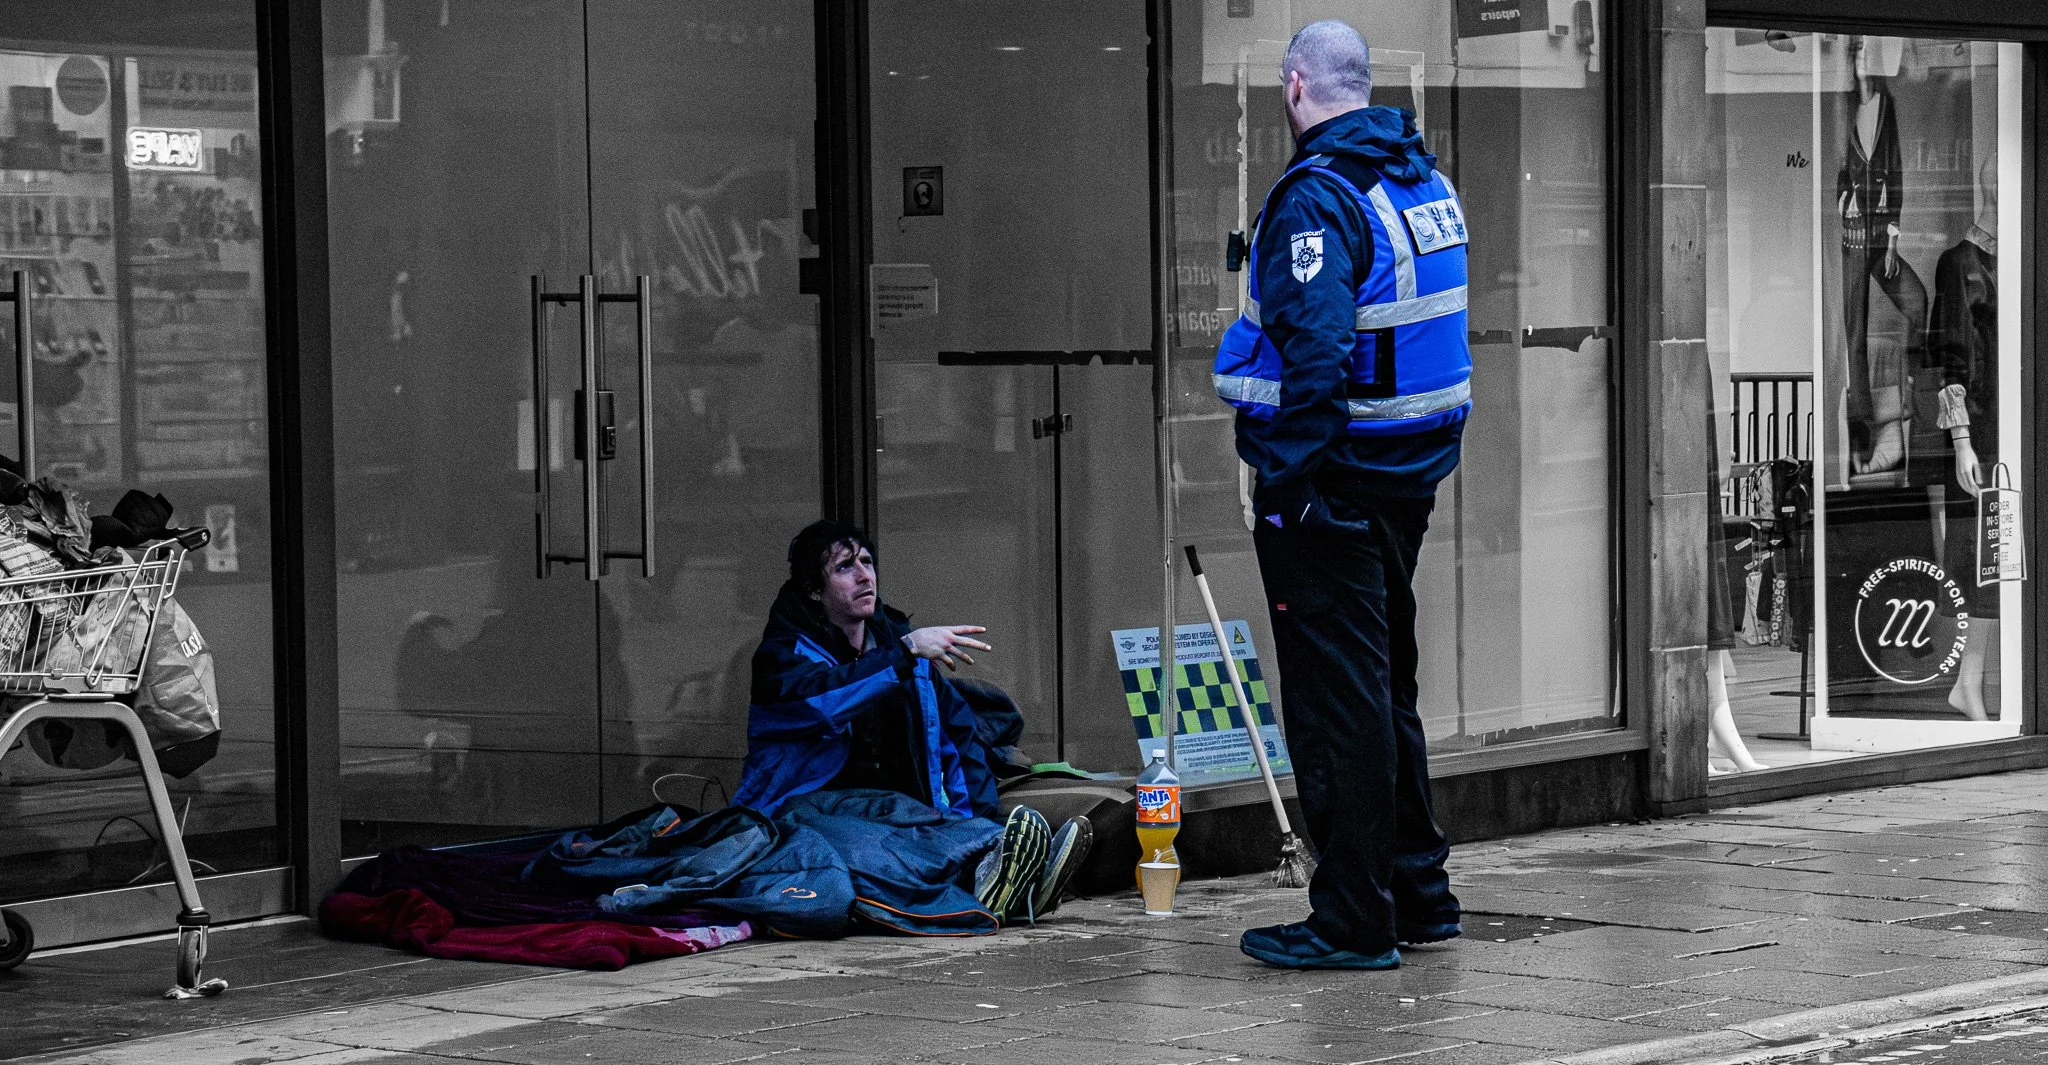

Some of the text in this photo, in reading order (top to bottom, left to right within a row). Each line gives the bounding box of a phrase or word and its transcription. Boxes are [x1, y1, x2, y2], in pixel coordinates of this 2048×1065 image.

[1786, 152, 1809, 168] We
[1859, 559, 1969, 674] FREE-SPIRITED FOR 50 YEARS
[1138, 790, 1170, 803] FANTA
